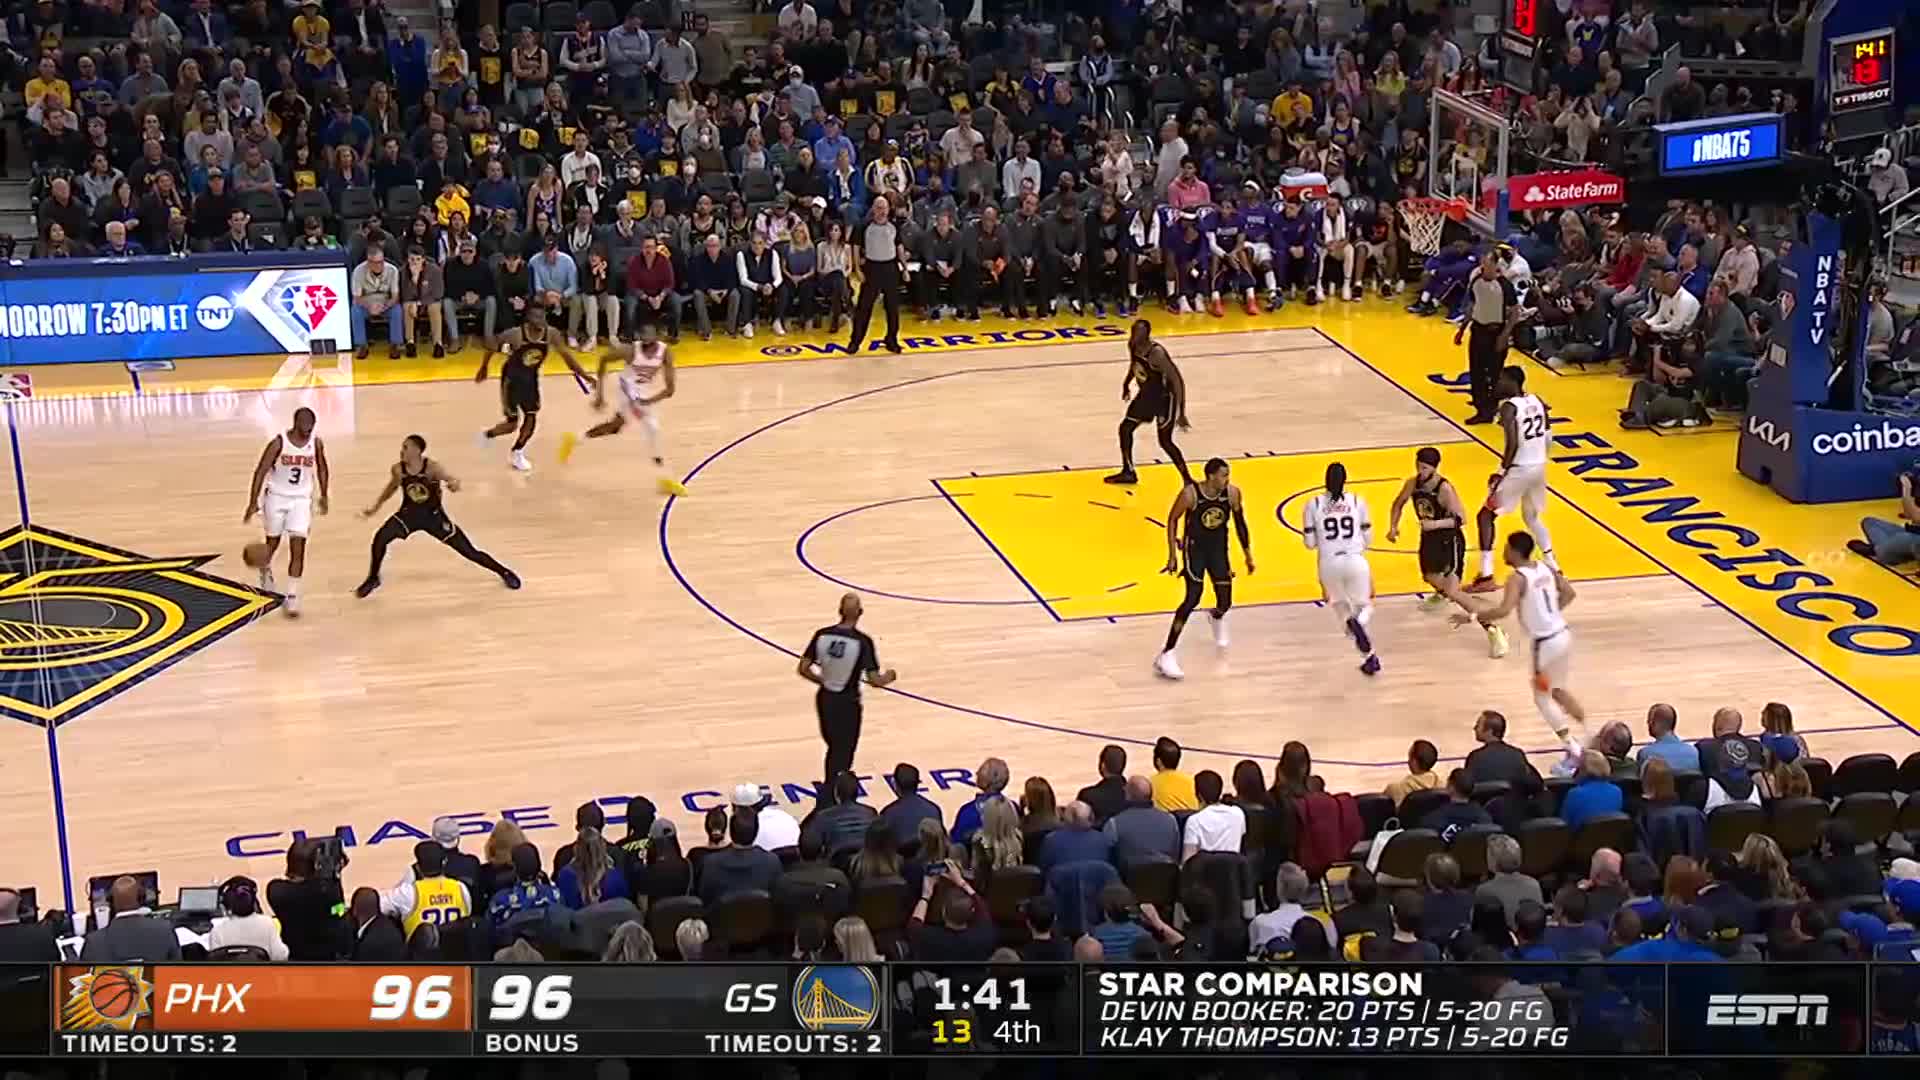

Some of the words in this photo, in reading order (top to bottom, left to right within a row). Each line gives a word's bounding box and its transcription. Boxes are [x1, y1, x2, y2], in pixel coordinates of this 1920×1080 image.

[169, 303, 188, 331] ET
[197, 307, 234, 322] TNT
[1523, 414, 1545, 440] 22
[288, 467, 302, 485] 3
[1323, 515, 1355, 541] 99
[1550, 431, 1920, 657] FRANCISCO
[1541, 587, 1553, 614] 1
